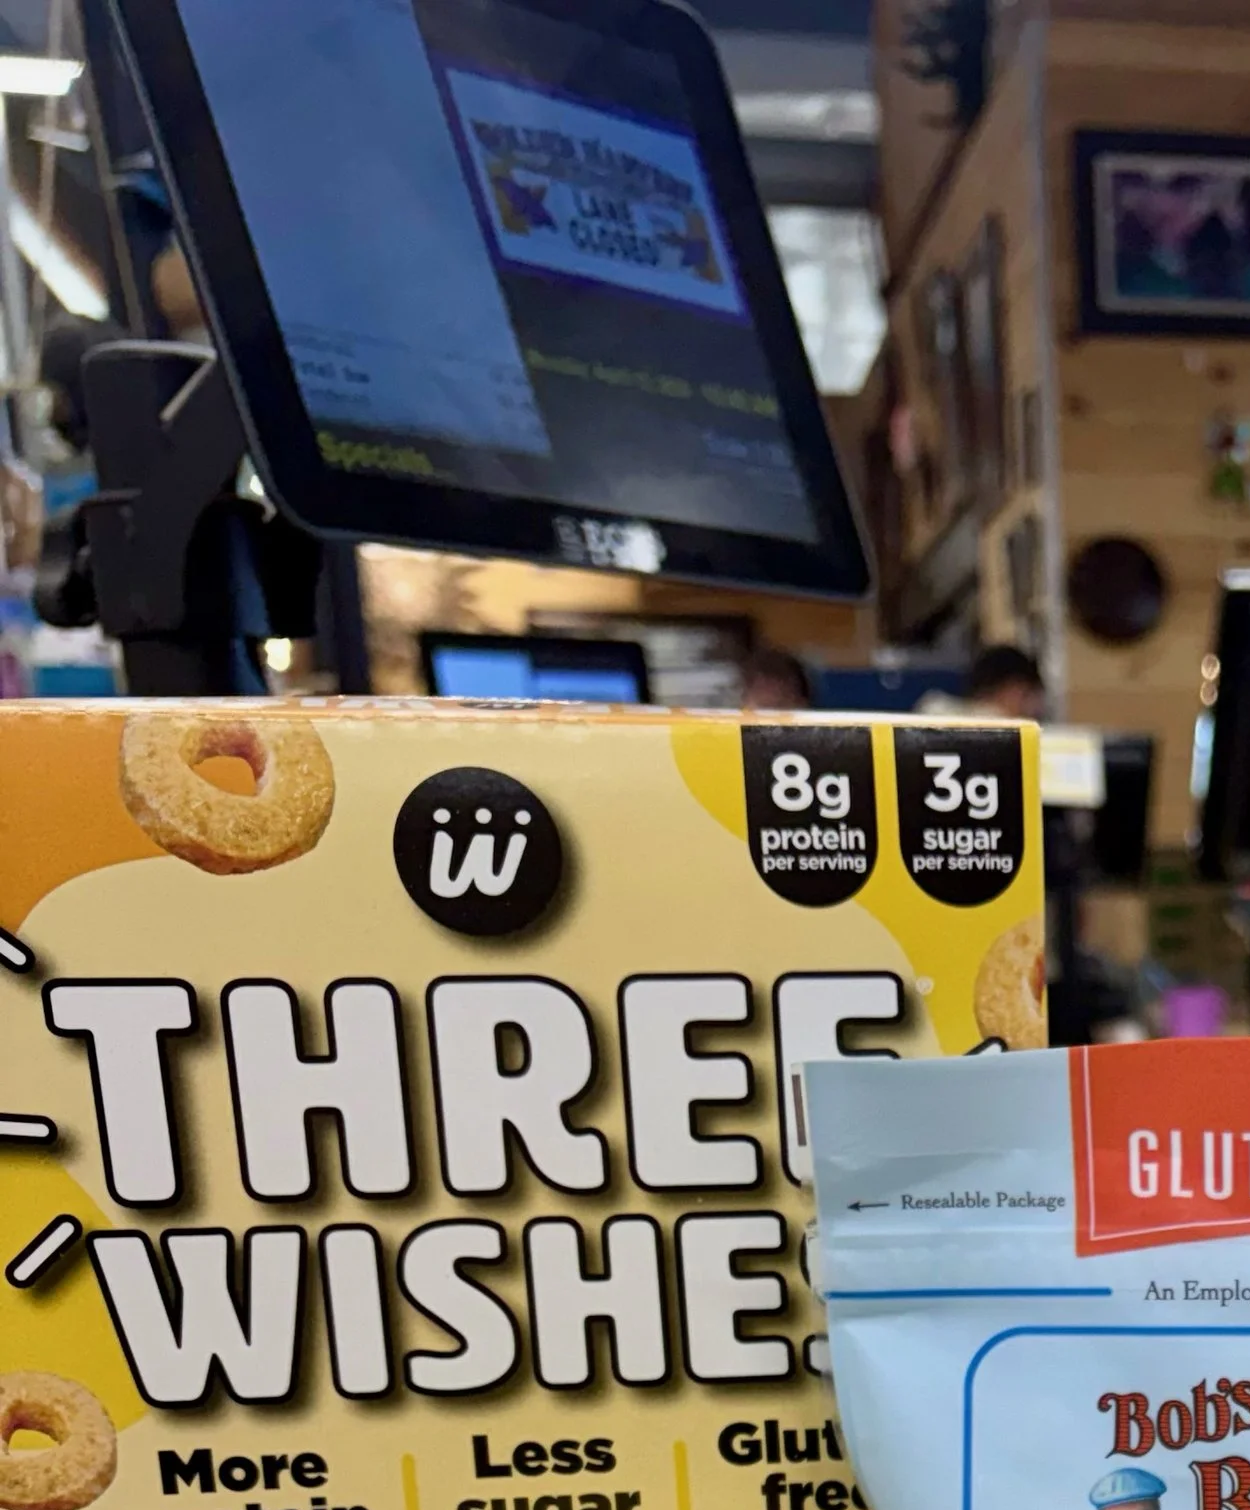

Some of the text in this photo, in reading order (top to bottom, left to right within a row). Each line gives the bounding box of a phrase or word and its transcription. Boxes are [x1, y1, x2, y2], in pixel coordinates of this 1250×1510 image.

[770, 752, 851, 819] 8g
[923, 753, 999, 819] 3g
[761, 824, 865, 854] protein
[923, 828, 1002, 854] sugar
[762, 853, 867, 873] per serving
[913, 853, 1013, 873] per serving
[901, 1191, 1066, 1214] Resealable Package
[86, 1210, 832, 1408] WISHE
[1145, 1281, 1175, 1301] An
[471, 1434, 617, 1478] Less
[717, 1419, 846, 1466] Glut
[157, 1448, 328, 1495] More
